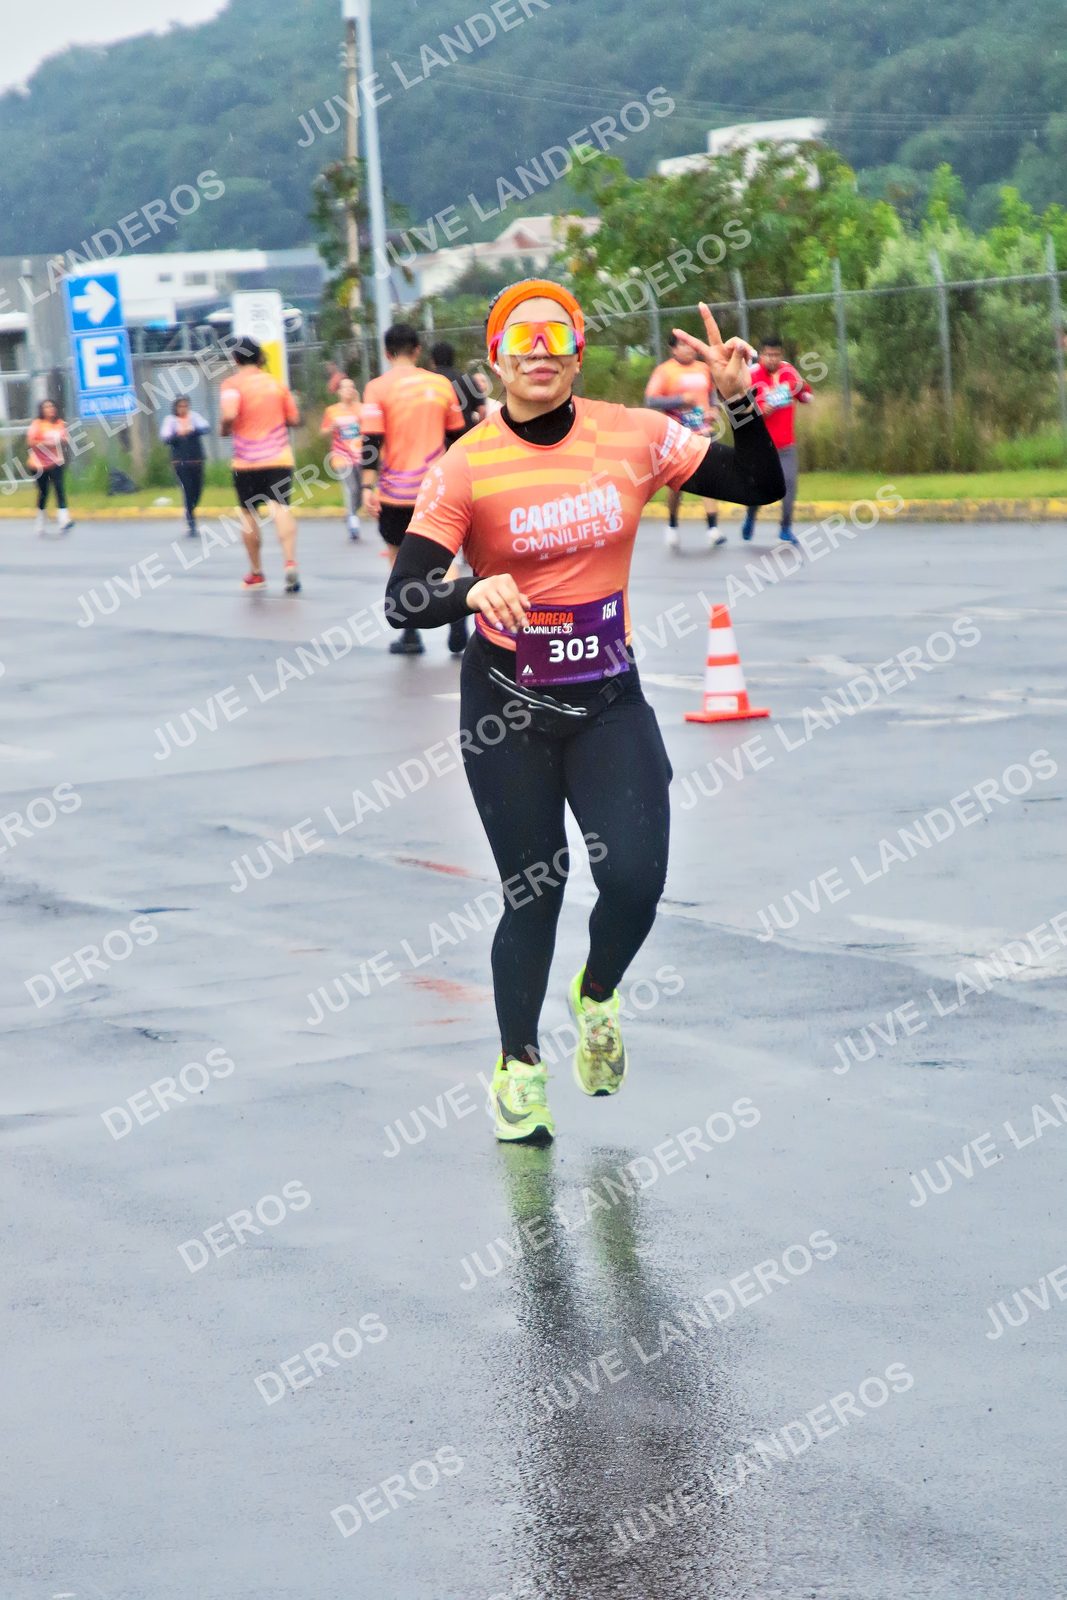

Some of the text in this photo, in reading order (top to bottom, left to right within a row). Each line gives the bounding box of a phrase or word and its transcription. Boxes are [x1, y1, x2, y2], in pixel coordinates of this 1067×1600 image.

[81, 335, 124, 388] E
[510, 485, 622, 534] CARRERA
[512, 520, 602, 553] OMNILIFE
[523, 625, 562, 635] OMNILIFE
[525, 612, 574, 626] CARRERA
[549, 635, 599, 663] 303
